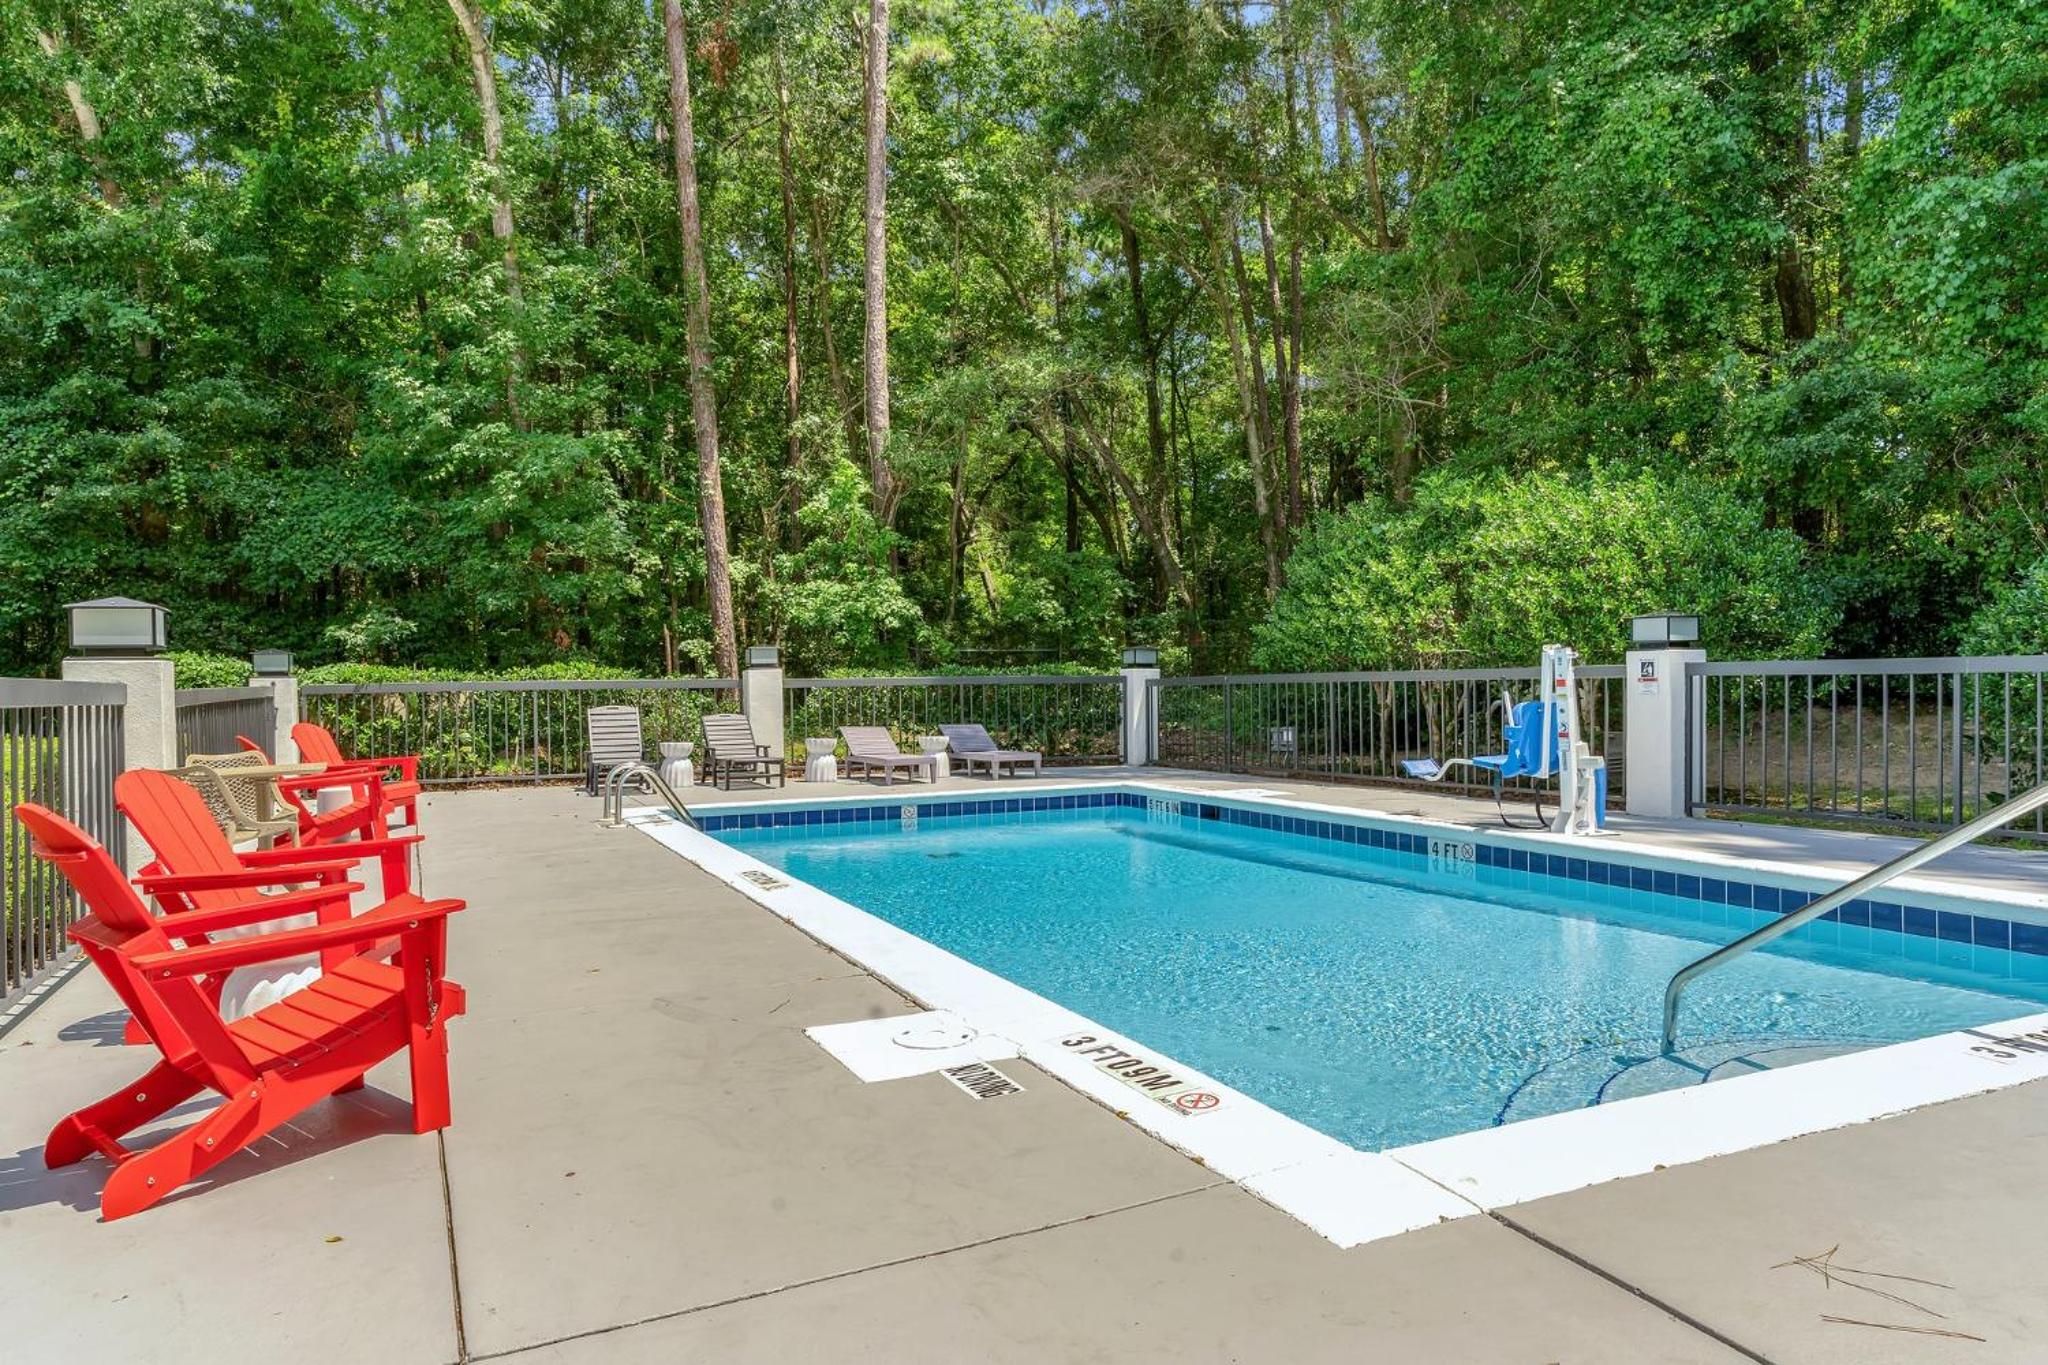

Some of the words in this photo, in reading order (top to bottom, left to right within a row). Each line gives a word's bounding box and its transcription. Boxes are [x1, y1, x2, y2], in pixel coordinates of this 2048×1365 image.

[1432, 841, 1439, 857] 4
[1444, 843, 1458, 860] FT
[1062, 1036, 1096, 1047] 3
[1970, 1046, 2017, 1059] 3
